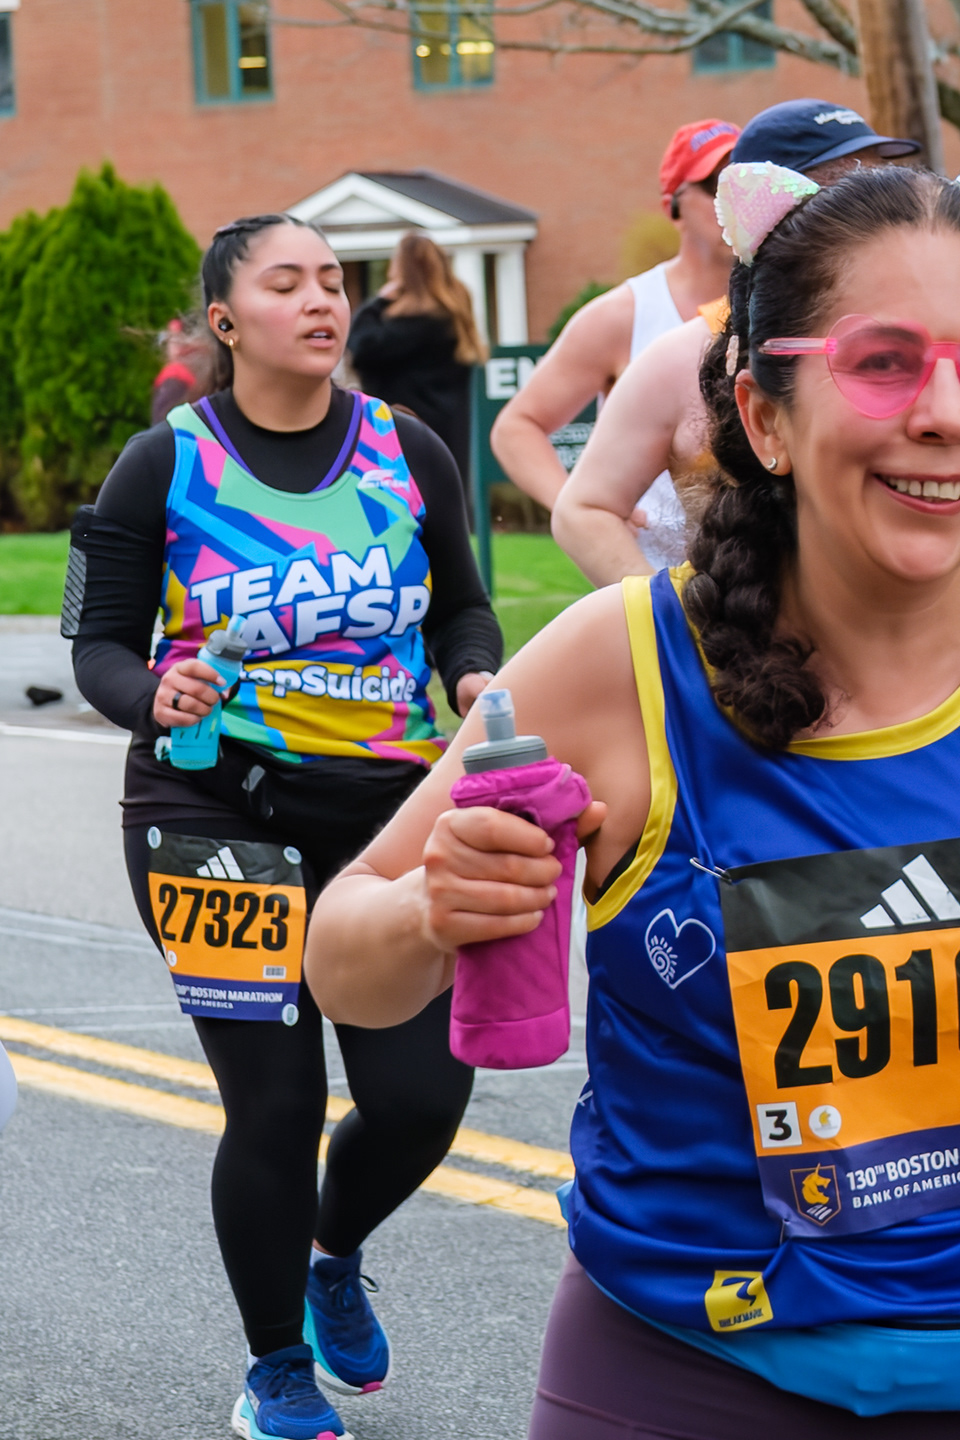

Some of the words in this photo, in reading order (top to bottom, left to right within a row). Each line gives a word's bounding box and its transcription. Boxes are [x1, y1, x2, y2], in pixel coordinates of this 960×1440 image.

[190, 546, 392, 625] TEAM
[241, 585, 430, 654] AFSP
[240, 664, 417, 702] opSuicide
[159, 884, 290, 952] 27323
[190, 985, 227, 1001] BOSTON
[227, 991, 283, 1003] MARATHON
[765, 1109, 792, 1141] 3
[886, 1148, 959, 1182] BOSTON
[852, 1190, 892, 1209] BANK
[893, 1183, 910, 1199] OF
